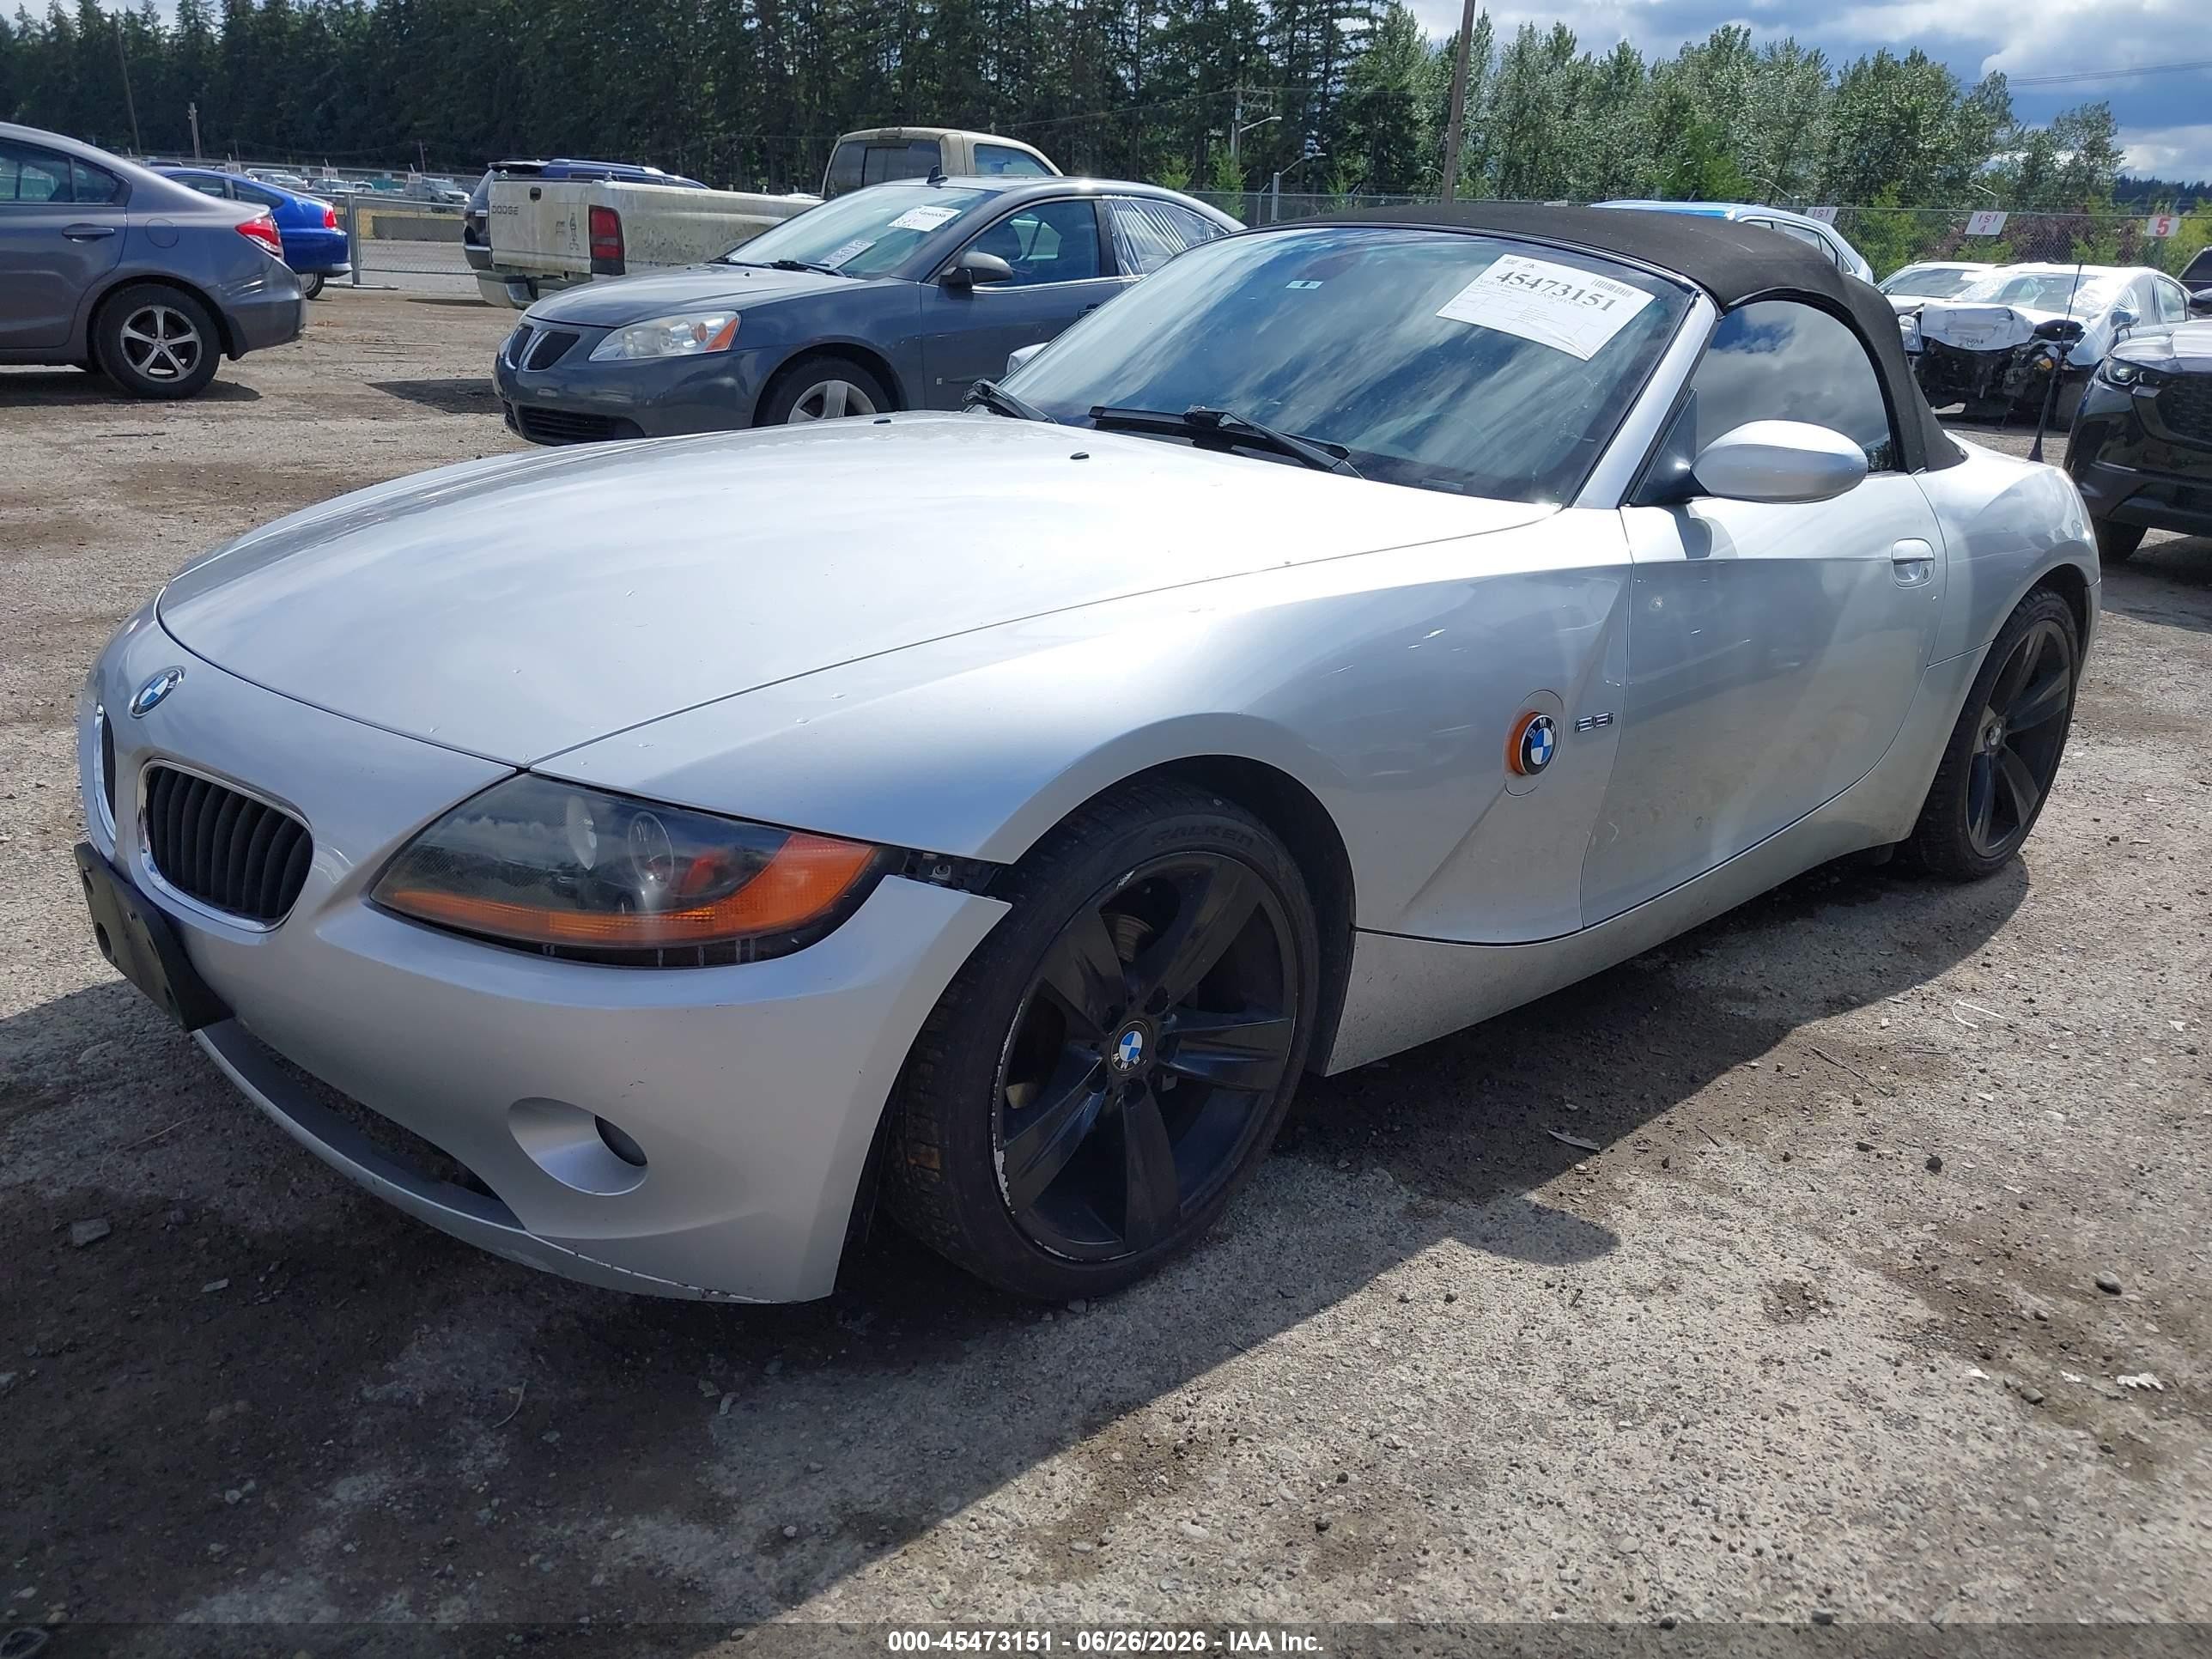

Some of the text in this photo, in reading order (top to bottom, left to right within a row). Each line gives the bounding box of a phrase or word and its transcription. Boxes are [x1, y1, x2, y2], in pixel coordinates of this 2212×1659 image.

[492, 205, 519, 216] DODGE
[2155, 214, 2172, 236] 5
[1496, 270, 1618, 311] 45473151
[1527, 717, 1556, 739] BMW
